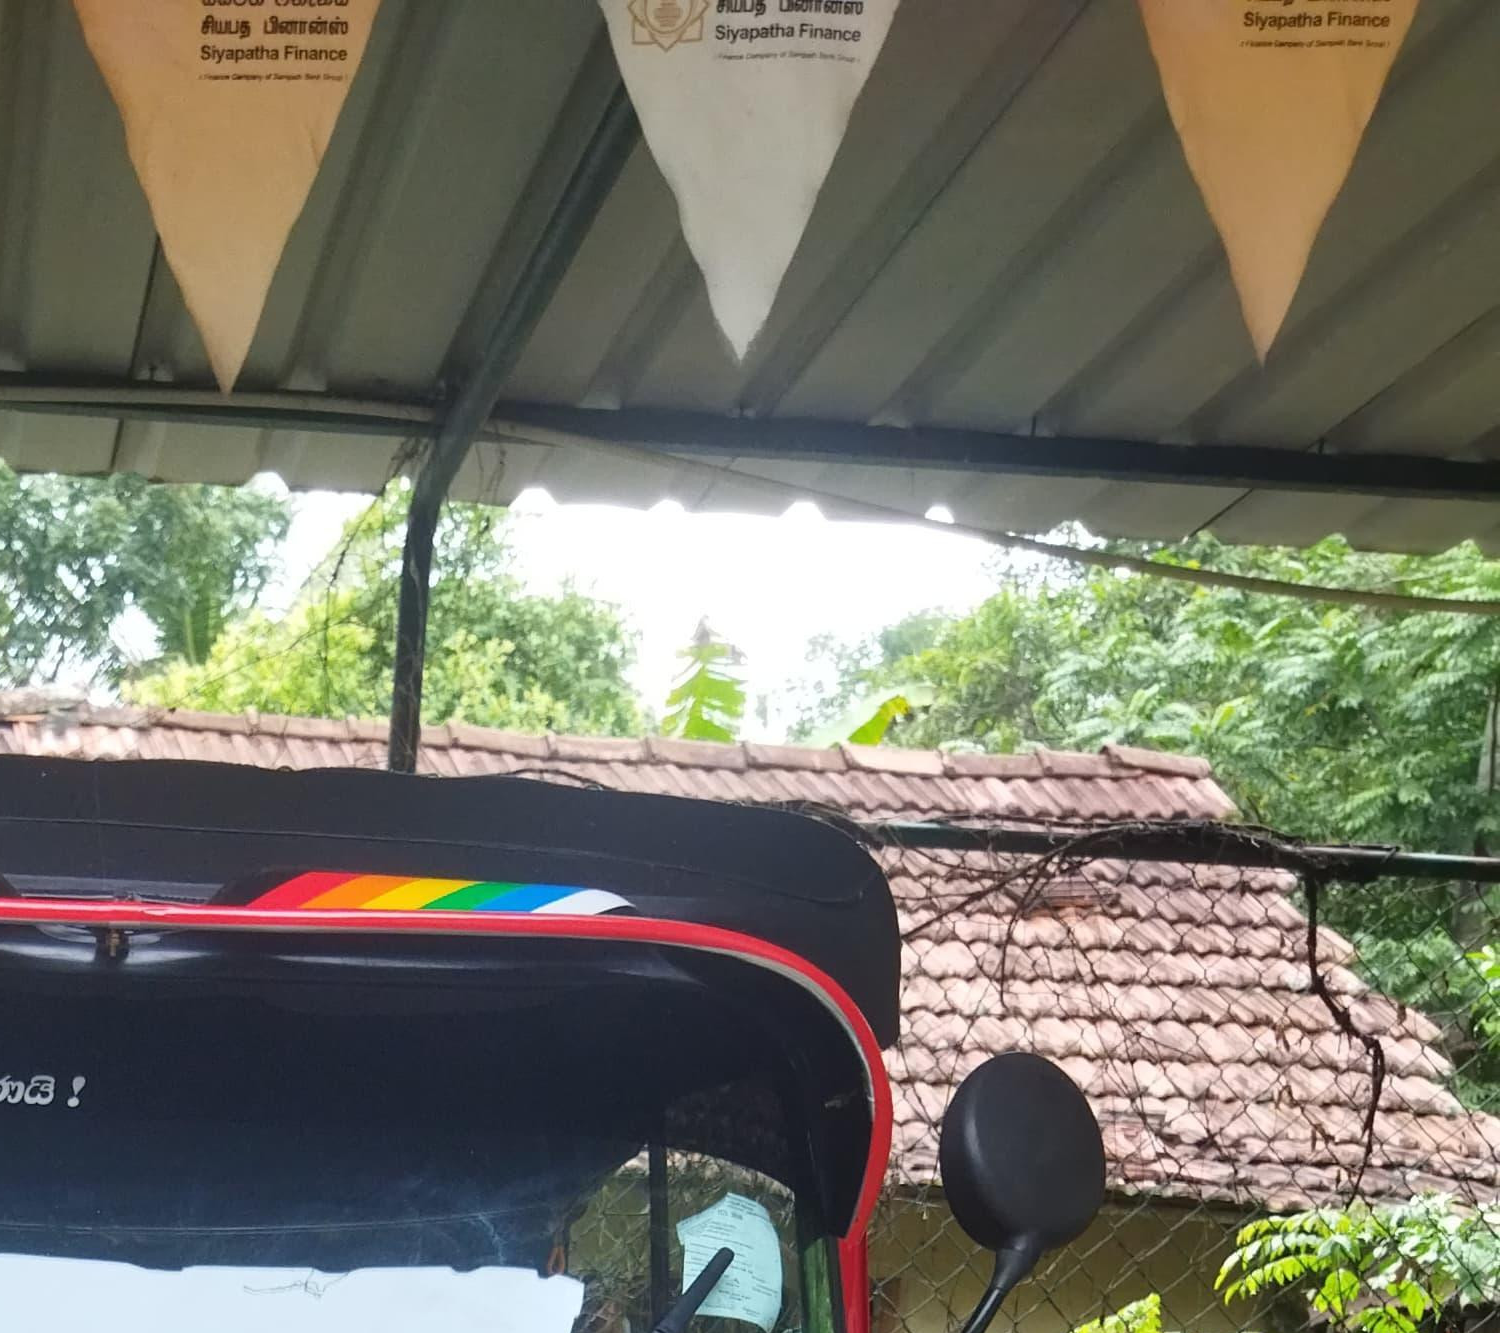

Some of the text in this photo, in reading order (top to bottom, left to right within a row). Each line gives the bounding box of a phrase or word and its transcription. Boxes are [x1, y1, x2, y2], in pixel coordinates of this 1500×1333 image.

[1243, 11, 1390, 31] Siyapatha Finance
[715, 23, 861, 44] Siyapatha Finance
[200, 45, 348, 64] Siyapatha Finance
